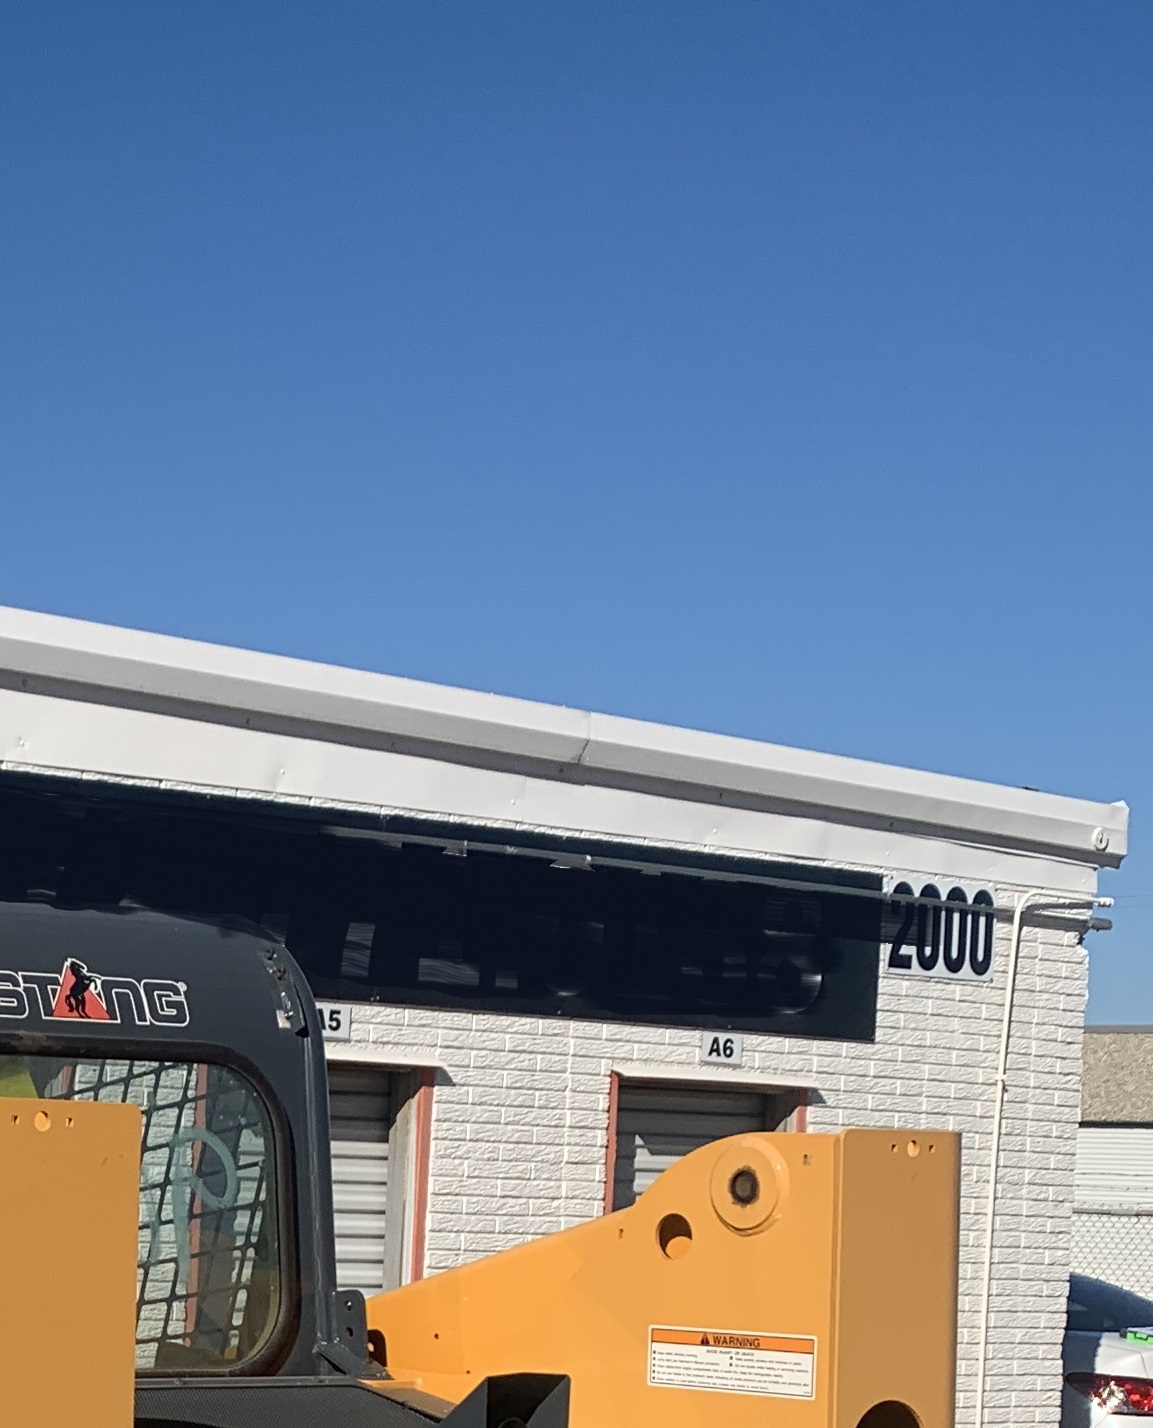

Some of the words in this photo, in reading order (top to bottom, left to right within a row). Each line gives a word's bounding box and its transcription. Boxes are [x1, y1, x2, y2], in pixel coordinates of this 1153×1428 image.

[889, 881, 995, 976] 2000
[707, 1036, 735, 1058] A6
[713, 1335, 761, 1349] WARNING
